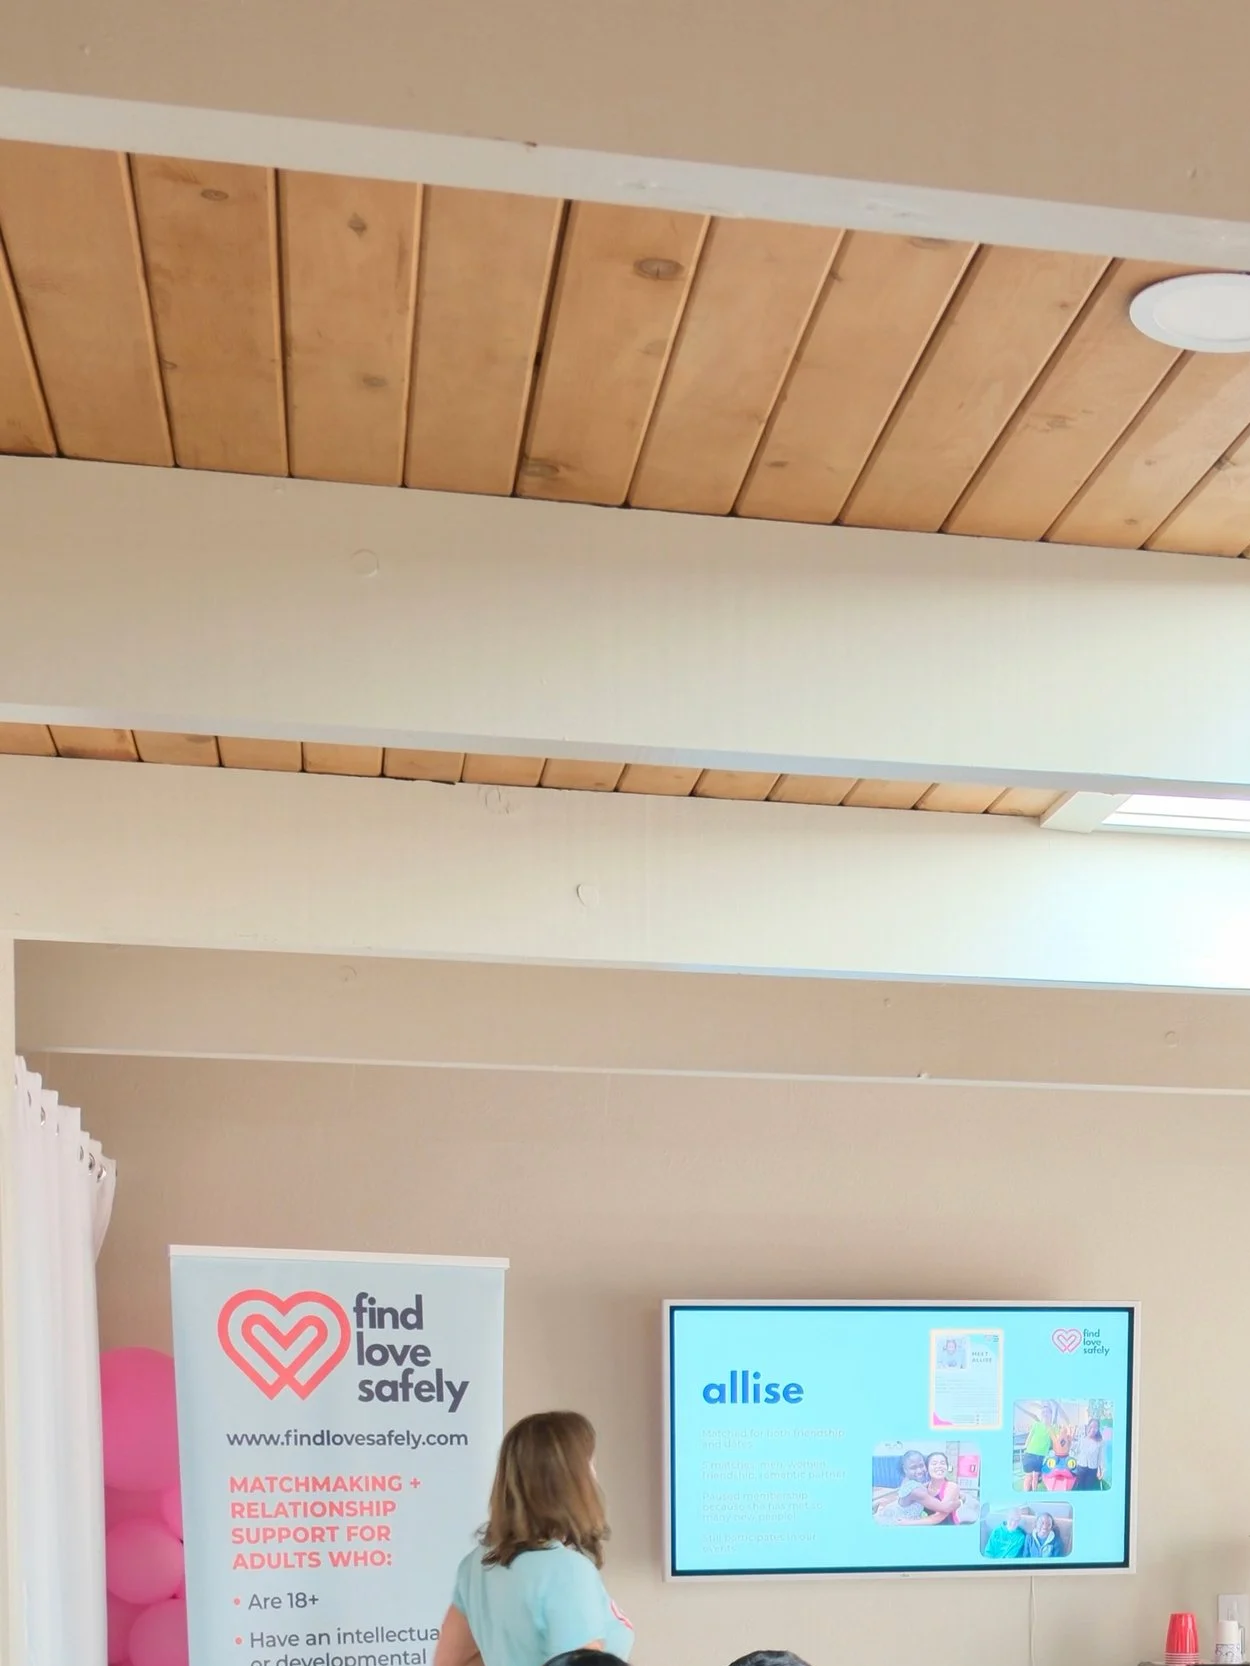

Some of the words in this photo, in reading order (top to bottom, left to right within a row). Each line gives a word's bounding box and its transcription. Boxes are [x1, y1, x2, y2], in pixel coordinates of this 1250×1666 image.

[353, 1292, 423, 1331] find
[1083, 1329, 1100, 1338] find
[1083, 1338, 1101, 1346] love
[358, 1332, 431, 1367] love
[1083, 1346, 1110, 1356] safely
[358, 1369, 469, 1412] safely
[702, 1370, 804, 1404] allise
[226, 1429, 469, 1449] www.findlovesafely.com
[230, 1475, 402, 1494] MATCHMAKING
[231, 1500, 397, 1519] RELATIONSHIP
[232, 1525, 339, 1545] SUPPORT
[347, 1525, 391, 1542] FOR
[232, 1551, 321, 1571] ADULTS
[327, 1549, 392, 1568] WHO:
[248, 1593, 282, 1610] Are
[287, 1592, 319, 1609] 18+
[250, 1631, 301, 1649] Have
[305, 1632, 331, 1646] an
[336, 1626, 440, 1645] intellectua
